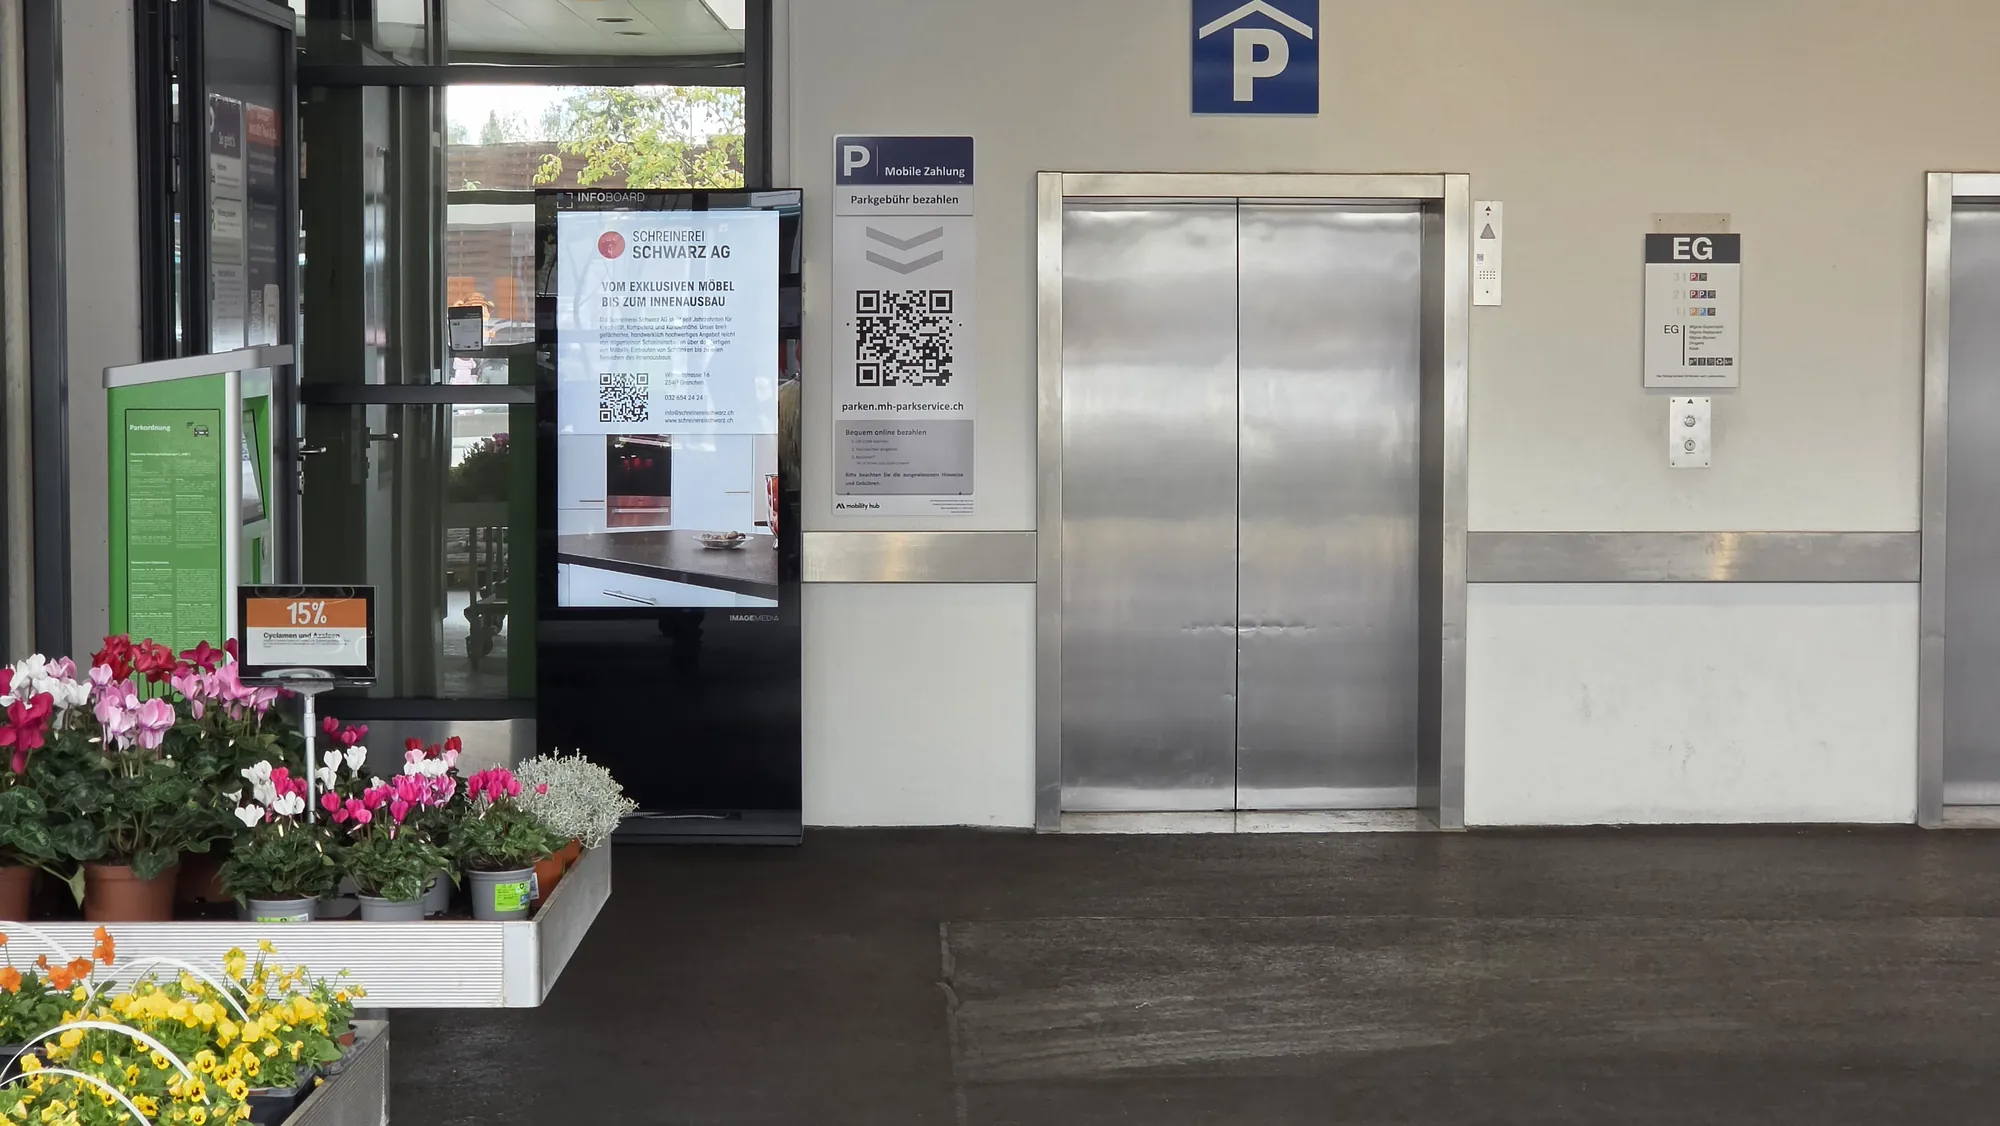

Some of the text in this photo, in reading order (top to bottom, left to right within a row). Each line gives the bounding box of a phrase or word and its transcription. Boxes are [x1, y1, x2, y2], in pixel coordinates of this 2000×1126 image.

[1233, 28, 1289, 102] P
[843, 145, 871, 176] P
[885, 166, 965, 178] Mobile Zahlung
[577, 192, 645, 202] INFOBOARD
[850, 194, 959, 206] Parkgebühr bezahlen
[633, 230, 705, 242] SCHREINEREI
[633, 245, 731, 259] SCHWARZ AG
[1673, 237, 1713, 260] EG
[602, 278, 735, 292] VOM EXKLUSIVEN MÖBEL
[602, 297, 726, 307] BIS ZUM INNENAUSBAU
[1664, 324, 1679, 334] EG
[842, 402, 964, 412] parken.mh-parkservice.ch
[129, 424, 171, 432] Parkordnung
[845, 429, 873, 437] Bequem
[286, 600, 327, 625] 15%
[263, 632, 297, 640] Cyclamen
